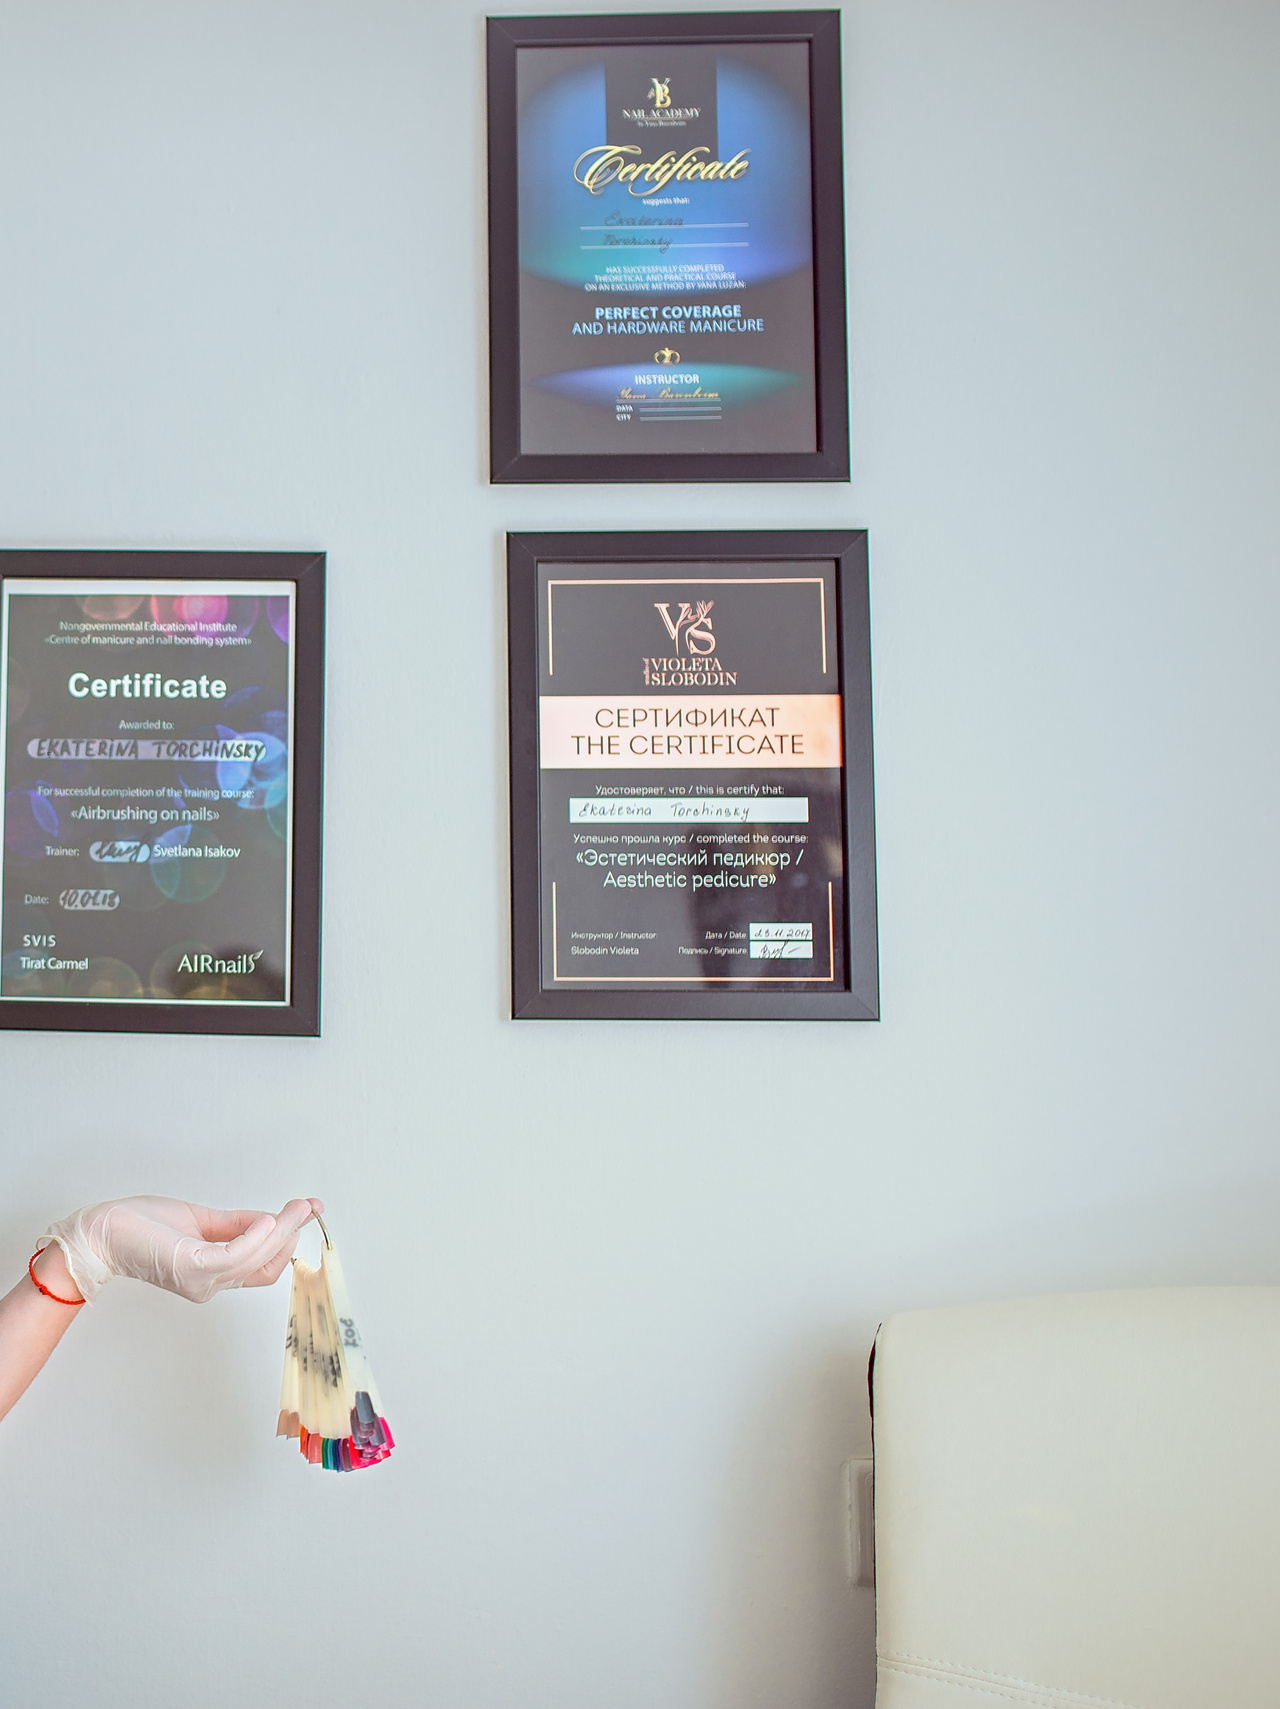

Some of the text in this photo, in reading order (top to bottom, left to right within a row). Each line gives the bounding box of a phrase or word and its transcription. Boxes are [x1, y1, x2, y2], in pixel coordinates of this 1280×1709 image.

[622, 107, 701, 119] NAIL ACADEMY
[573, 144, 751, 196] Certificate
[642, 197, 672, 206] suggests
[623, 265, 677, 273] SUCCESSFULLY
[679, 264, 725, 272] COMPLETED
[594, 272, 736, 282] THEORETICAL AND PRACTICAL COURSE
[585, 283, 597, 291] ON
[598, 283, 610, 291] AN
[611, 282, 650, 291] EXCLUSIVE
[651, 282, 684, 290] METHOD
[686, 281, 696, 290] BY
[697, 281, 717, 289] YANA
[594, 304, 742, 320] PERFECT COVERAGE
[572, 318, 764, 335] AND HARDWARE MANICURE
[634, 373, 700, 385] INSTRUCTOR
[616, 404, 633, 413] DATA
[616, 413, 632, 421] CITY
[59, 621, 238, 633] Nongovernmental Educational Institute
[80, 634, 91, 645] of
[92, 635, 134, 645] manicure
[136, 635, 155, 645] and
[156, 635, 173, 645] nail
[174, 635, 214, 648] bonding
[651, 657, 722, 671] VIOLETA
[68, 672, 227, 699] Certificate
[651, 672, 737, 686] SLOBODIN
[594, 707, 780, 728] СЕРТИФИКАТ
[119, 720, 175, 730] Awarded to:
[571, 734, 804, 755] THE CERTIFICATE
[37, 786, 52, 796] For
[53, 786, 100, 797] successful
[101, 787, 154, 799] completion
[155, 787, 166, 797] of
[166, 788, 182, 797] the
[183, 788, 219, 800] training
[595, 784, 785, 797] Удостоверяет, что this is certify that:
[71, 806, 220, 824] «Airbrushing on nails»
[573, 833, 619, 845] Успешно
[621, 835, 661, 845] прошла
[662, 835, 687, 847] курс
[696, 833, 751, 846] completed
[752, 833, 770, 844] the
[45, 845, 80, 857] Trainer:
[152, 844, 203, 858] Svetlana
[205, 845, 241, 858] Isakov
[576, 848, 791, 870] «Эстетический педикюр
[602, 870, 777, 892] Aesthetic pedicure»
[24, 893, 50, 905] Date:
[22, 934, 56, 948] SVIS
[571, 931, 657, 942] Инструктор Instructor
[705, 930, 723, 940] Дата
[571, 946, 639, 956] Slobodin Violeta
[678, 946, 709, 956] Подпись
[714, 946, 747, 957] Signature
[20, 956, 89, 971] Tirat Carmel
[177, 949, 264, 974] AIRnails
